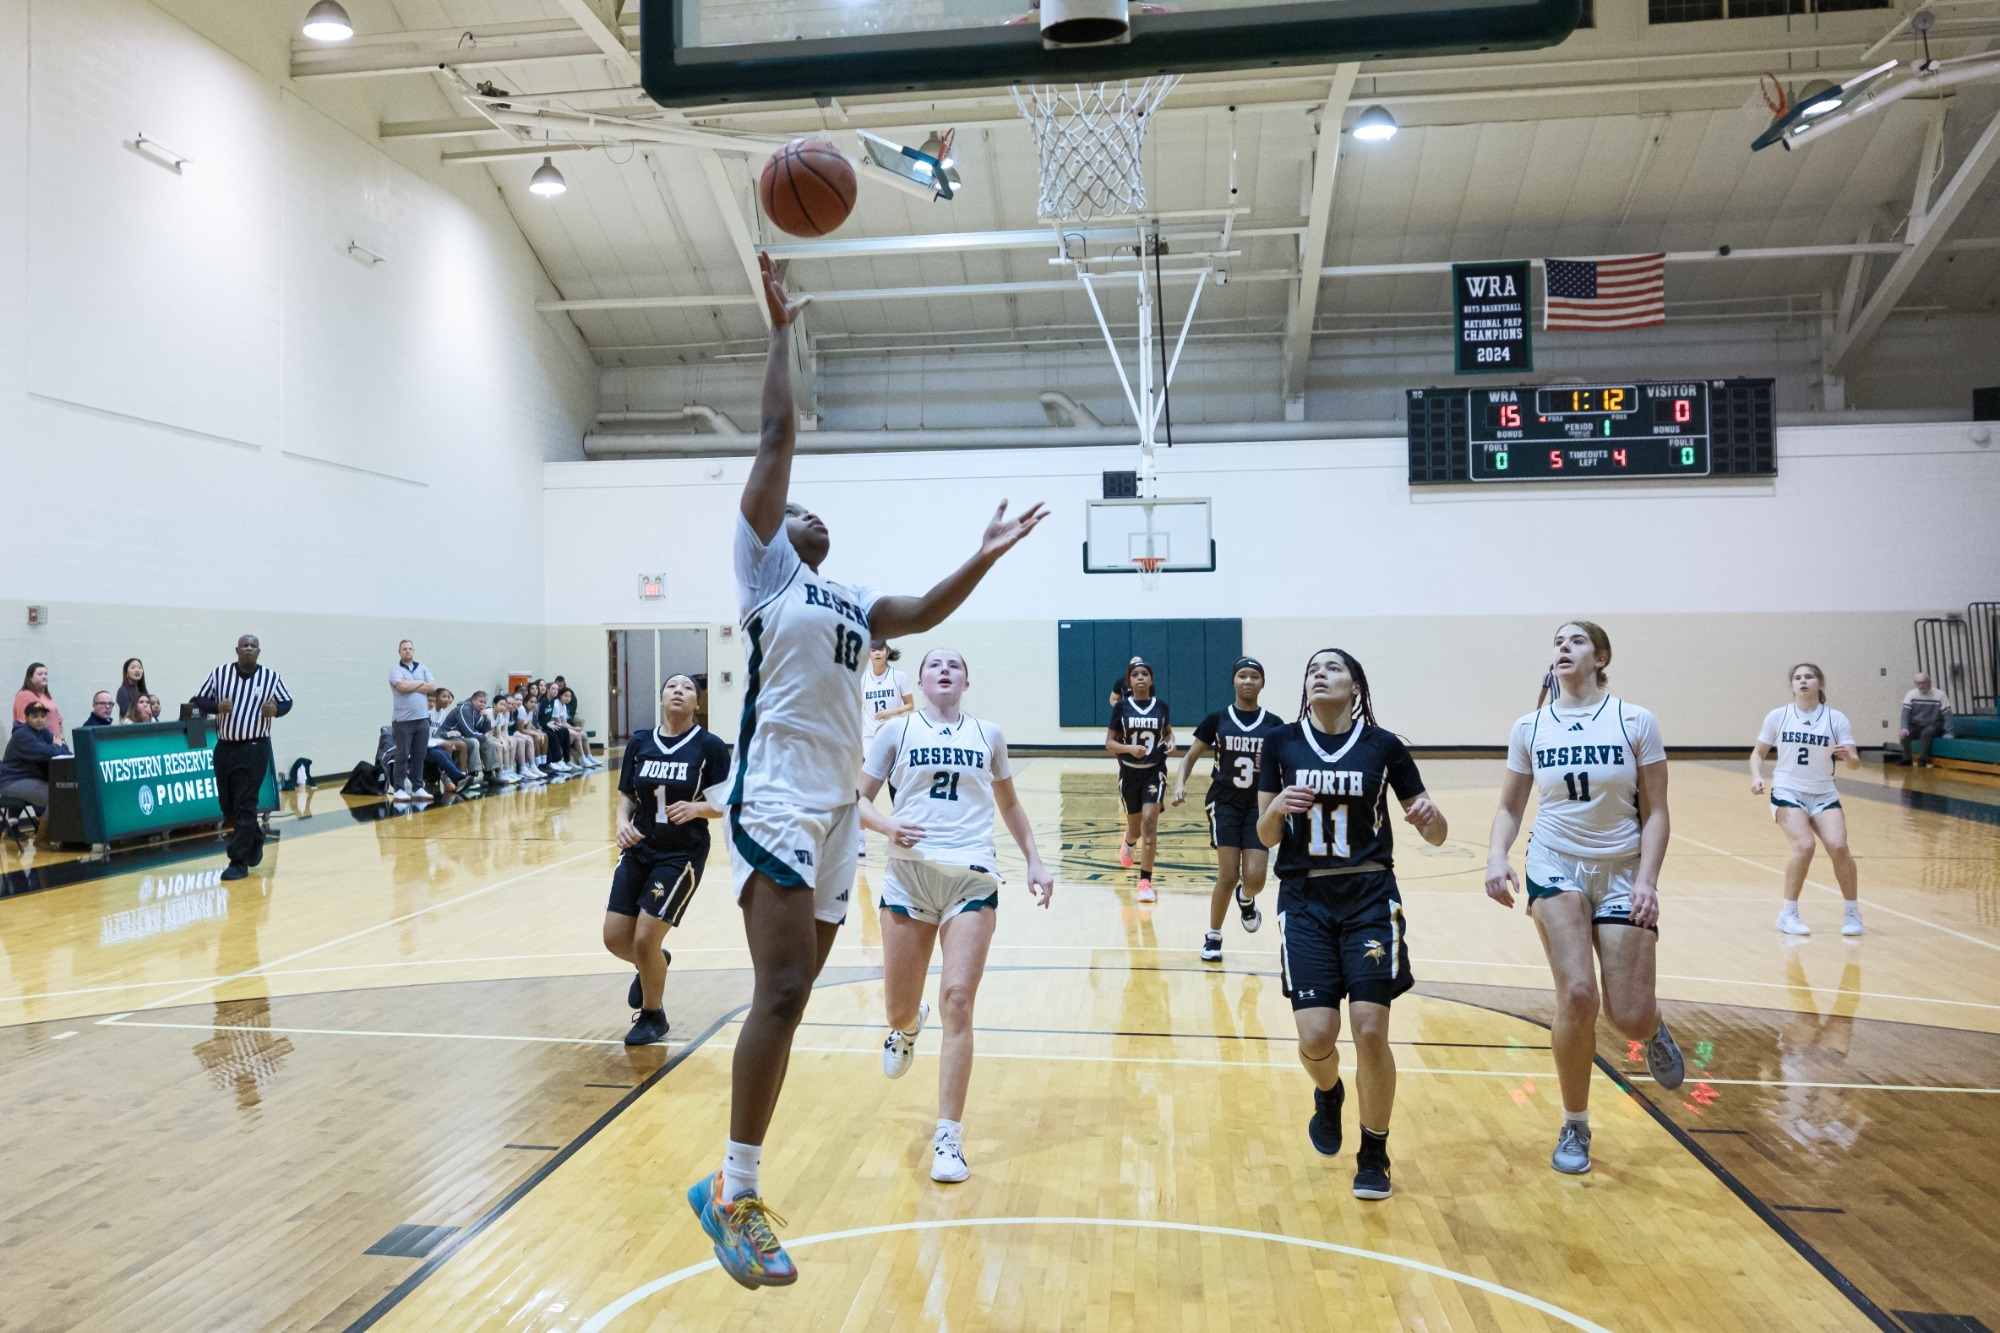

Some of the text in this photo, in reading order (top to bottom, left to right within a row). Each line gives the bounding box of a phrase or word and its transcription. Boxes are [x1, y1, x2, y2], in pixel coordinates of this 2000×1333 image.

[1466, 275, 1517, 297] WRA
[1464, 303, 1521, 313] BOYS BASKETBALL
[1464, 318, 1522, 328] NATIONAL PREP
[1464, 328, 1523, 341] CHAMPIONS
[1477, 347, 1510, 362] 2024
[1489, 391, 1518, 402] WRA
[1573, 389, 1624, 411] 1:12
[1647, 385, 1697, 397] VISITOR
[1501, 405, 1521, 427] 15
[1675, 400, 1690, 422] 0
[1497, 430, 1523, 438] BONUS
[1565, 423, 1594, 431] PERIOD
[1604, 419, 1610, 436] 1
[1653, 425, 1680, 434] BONUS
[1484, 444, 1508, 452] FOULS
[1669, 438, 1694, 446] FOULS
[1496, 452, 1508, 470] 0
[1551, 450, 1563, 468] 5
[1569, 450, 1608, 459] TIMEOUTS
[1580, 458, 1598, 466] LEFT
[1614, 449, 1626, 466] 4
[1681, 447, 1694, 465] 0
[834, 623, 863, 671] 10
[865, 689, 894, 700] RESERVE
[874, 701, 887, 713] 13
[1128, 717, 1158, 729] NORTH
[1130, 731, 1155, 756] 13
[1782, 731, 1830, 747] RESERVE
[909, 747, 984, 769] RESERVE
[1536, 745, 1625, 769] RESERVE
[1797, 747, 1809, 765] 2
[100, 749, 214, 783] WESTERN RESERVE
[639, 759, 689, 781] NORTH
[1233, 756, 1254, 789] 3
[930, 771, 960, 801] 21
[1295, 769, 1364, 796] NORTH
[1563, 772, 1591, 802] 11
[653, 785, 668, 824] 1
[1307, 803, 1351, 858] 11
